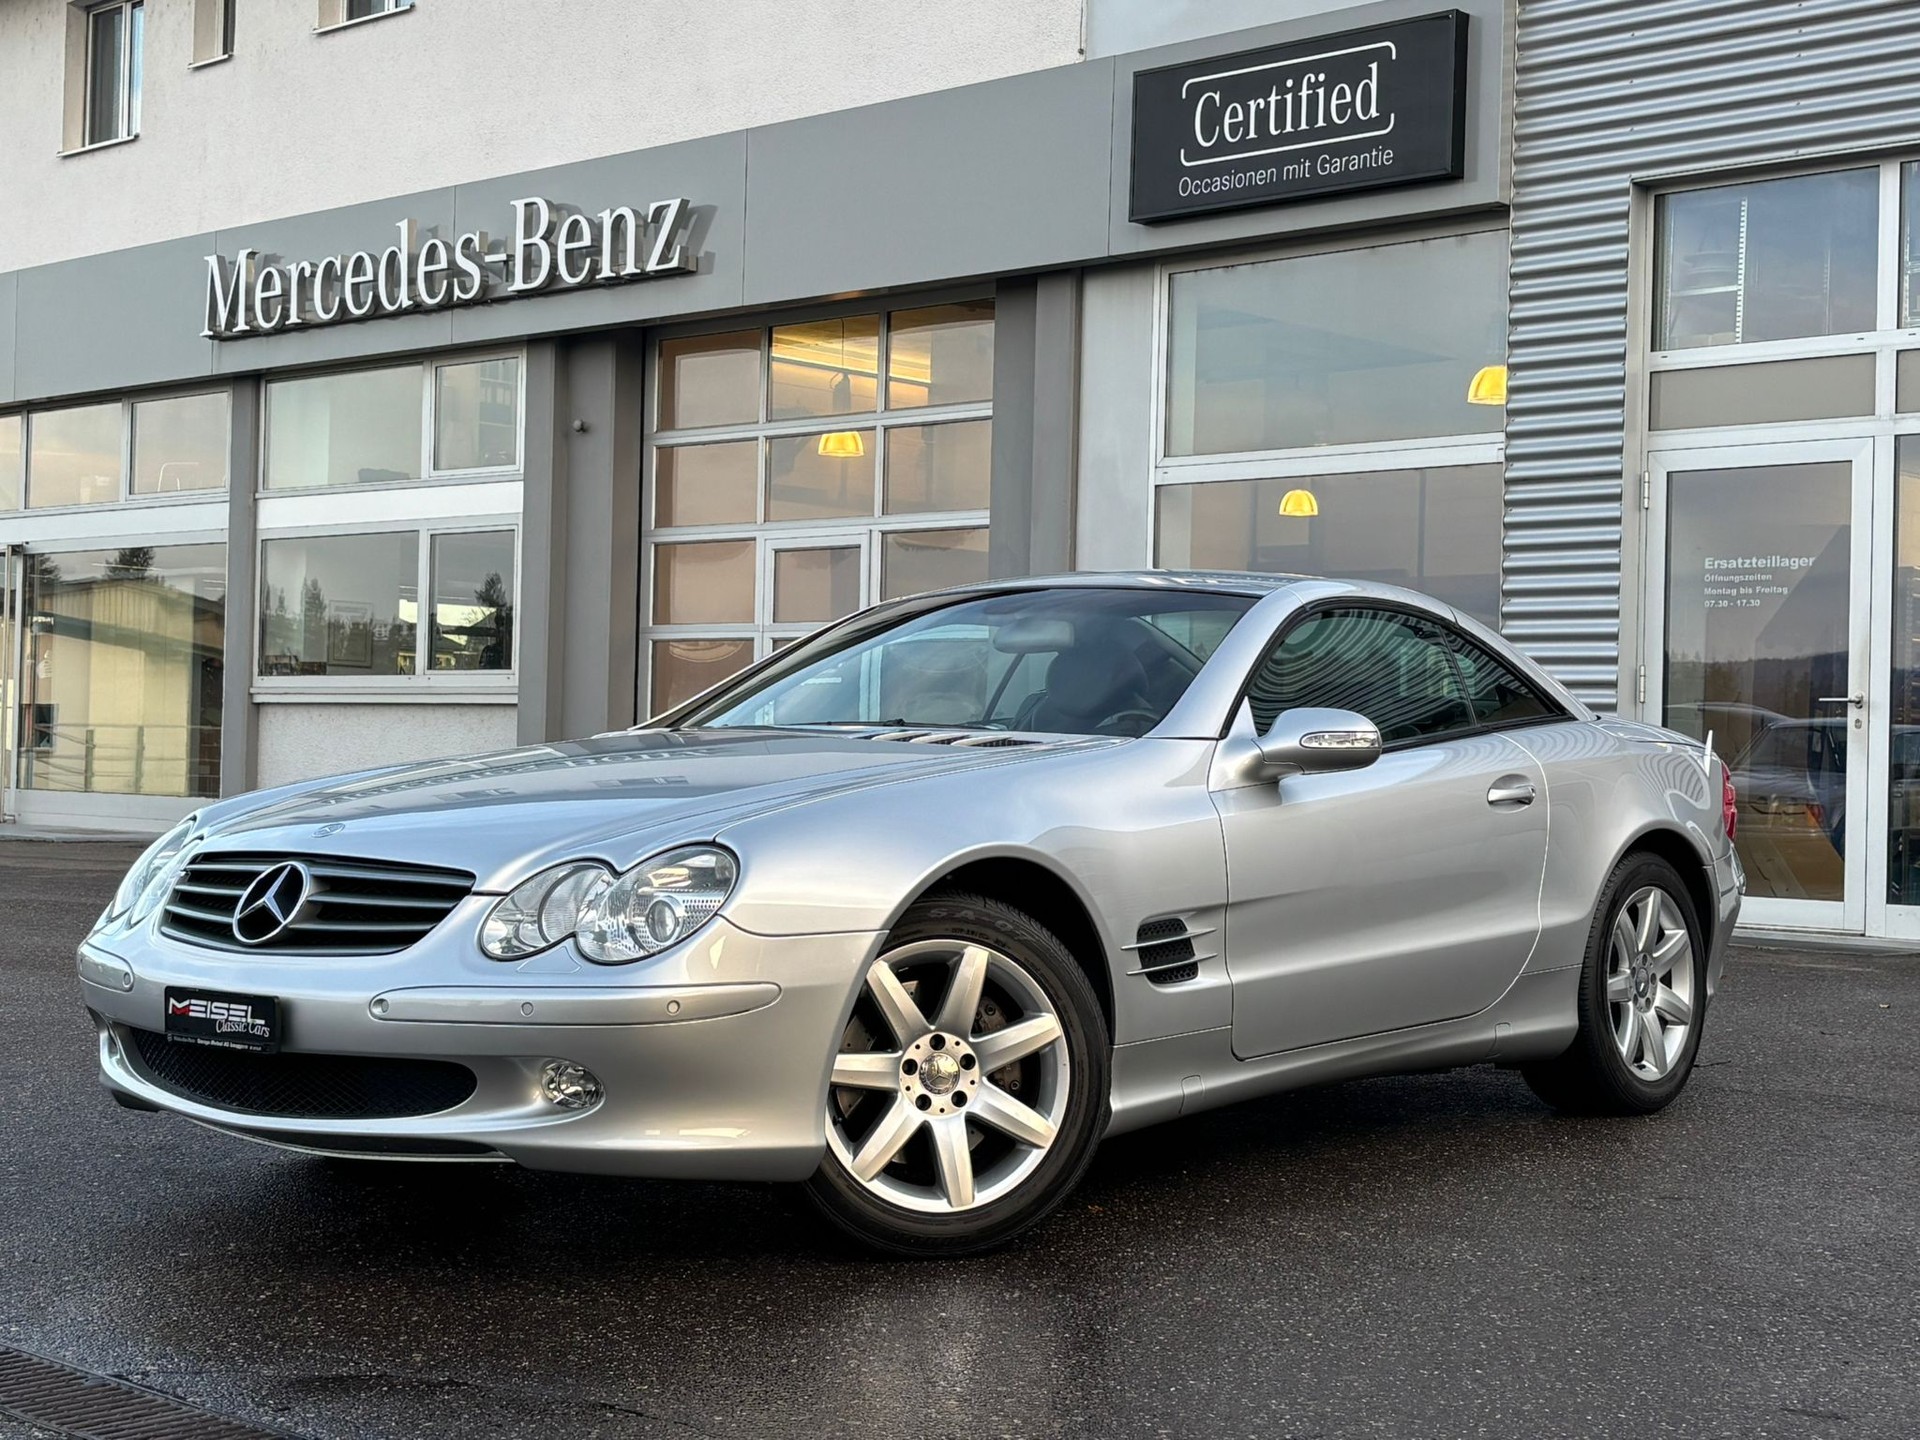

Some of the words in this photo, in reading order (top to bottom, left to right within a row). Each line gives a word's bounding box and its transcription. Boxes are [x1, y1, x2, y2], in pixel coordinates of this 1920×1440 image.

[1194, 61, 1380, 148] Certified
[1178, 167, 1277, 197] Occasionen
[1283, 159, 1311, 181] mit
[1317, 145, 1394, 176] Garantie
[199, 196, 693, 338] Mercedes-Benz
[1704, 555, 1816, 570] Ersatzteillager
[1704, 573, 1773, 584] Öffnungszeiten
[1704, 587, 1737, 597] Montag
[1740, 586, 1753, 595] bis
[1756, 585, 1789, 596] Freitag
[1704, 599, 1729, 609] 07.30
[1736, 598, 1761, 608] 17.30
[168, 997, 266, 1025] MEISEL
[215, 1018, 248, 1034] Classic
[248, 1021, 271, 1038] Cars
